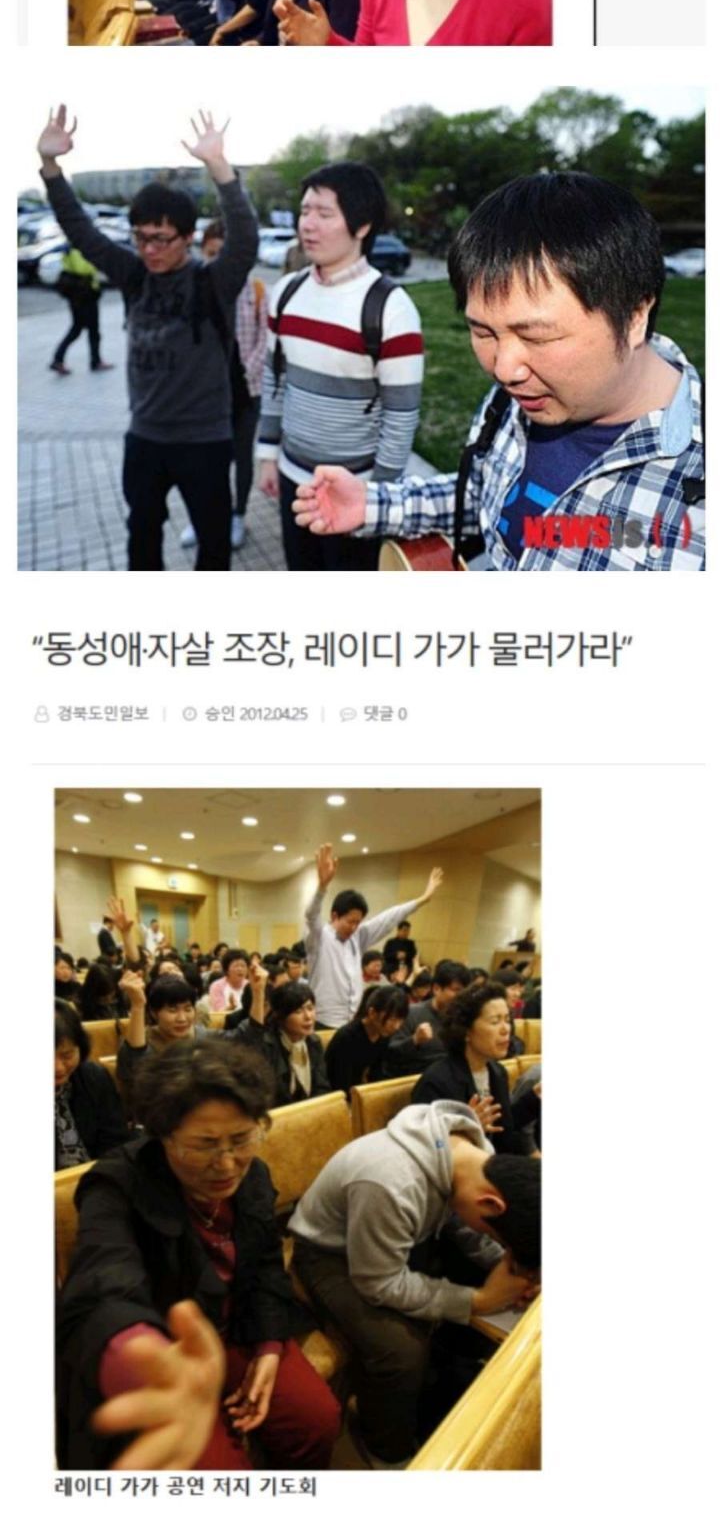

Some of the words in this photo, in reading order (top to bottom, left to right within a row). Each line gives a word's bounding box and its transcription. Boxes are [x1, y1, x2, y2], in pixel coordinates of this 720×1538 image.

[223, 632, 294, 668] 조장,
[305, 632, 400, 667] 레이디
[414, 632, 480, 667] 가가
[58, 705, 149, 722] 경북도민일보
[204, 705, 235, 722] 승인
[240, 706, 309, 721] 2012.04.25
[363, 705, 393, 722] 댓글
[398, 706, 407, 721] 0
[54, 1477, 112, 1497] 레이디
[121, 1477, 158, 1497] 가가
[167, 1477, 204, 1497] 공연
[213, 1477, 250, 1497] 저지
[260, 1477, 317, 1497] 기도회
